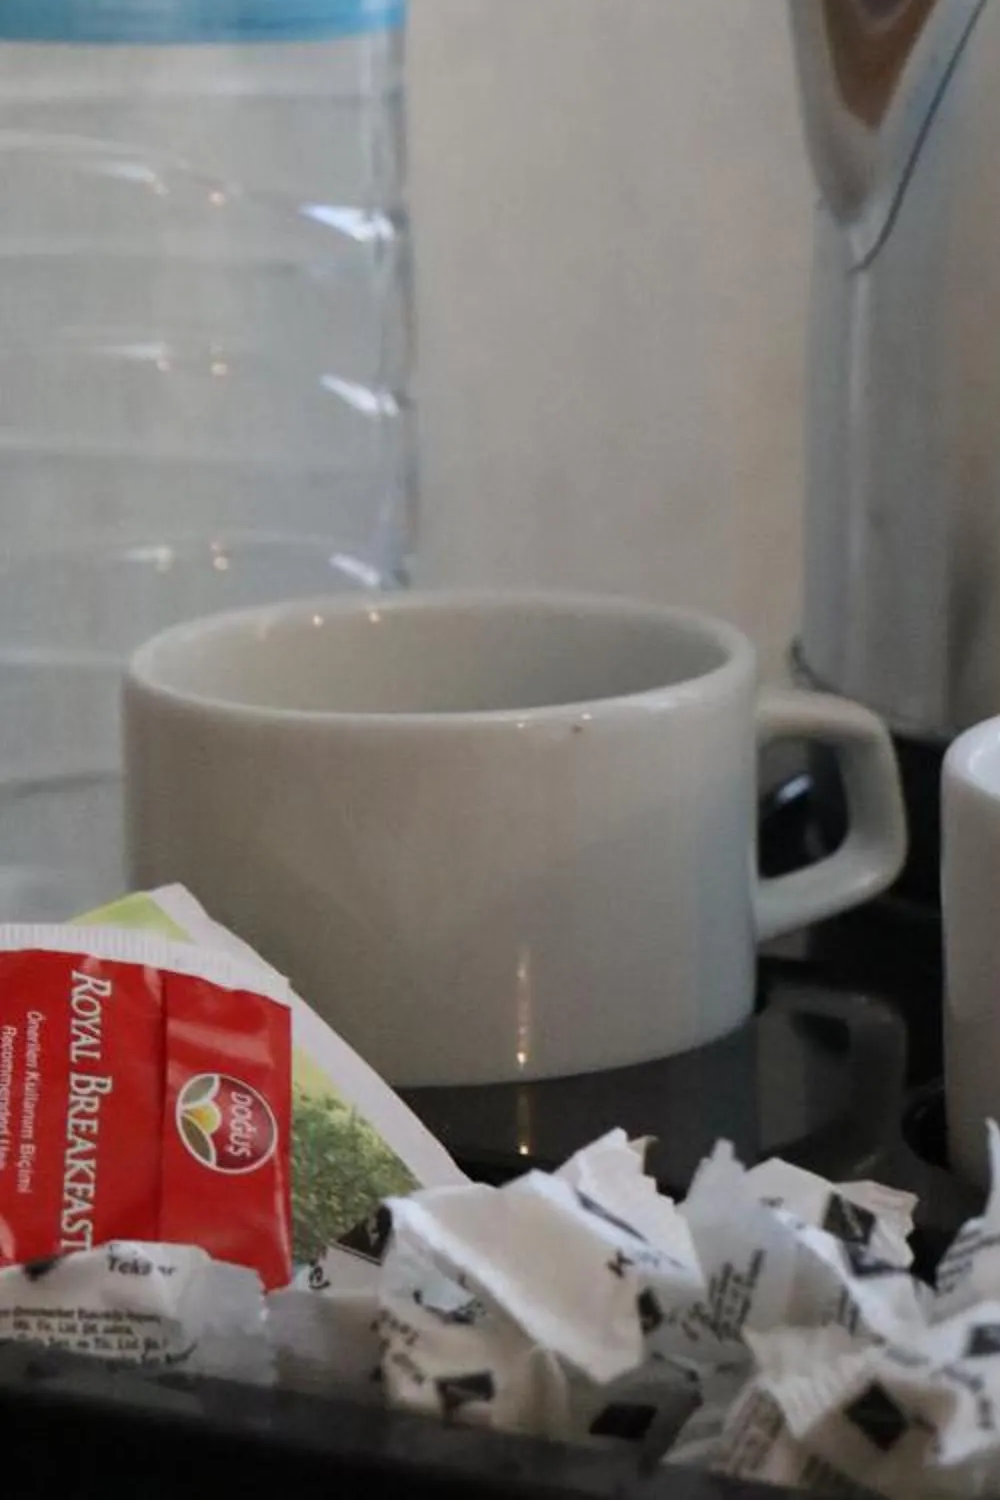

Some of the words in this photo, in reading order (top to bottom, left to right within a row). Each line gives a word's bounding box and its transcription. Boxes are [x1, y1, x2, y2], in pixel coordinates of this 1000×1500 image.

[69, 970, 113, 1062] ROYAL
[61, 1071, 114, 1253] BREAKFAST
[228, 1090, 258, 1158] DOĞUŞ
